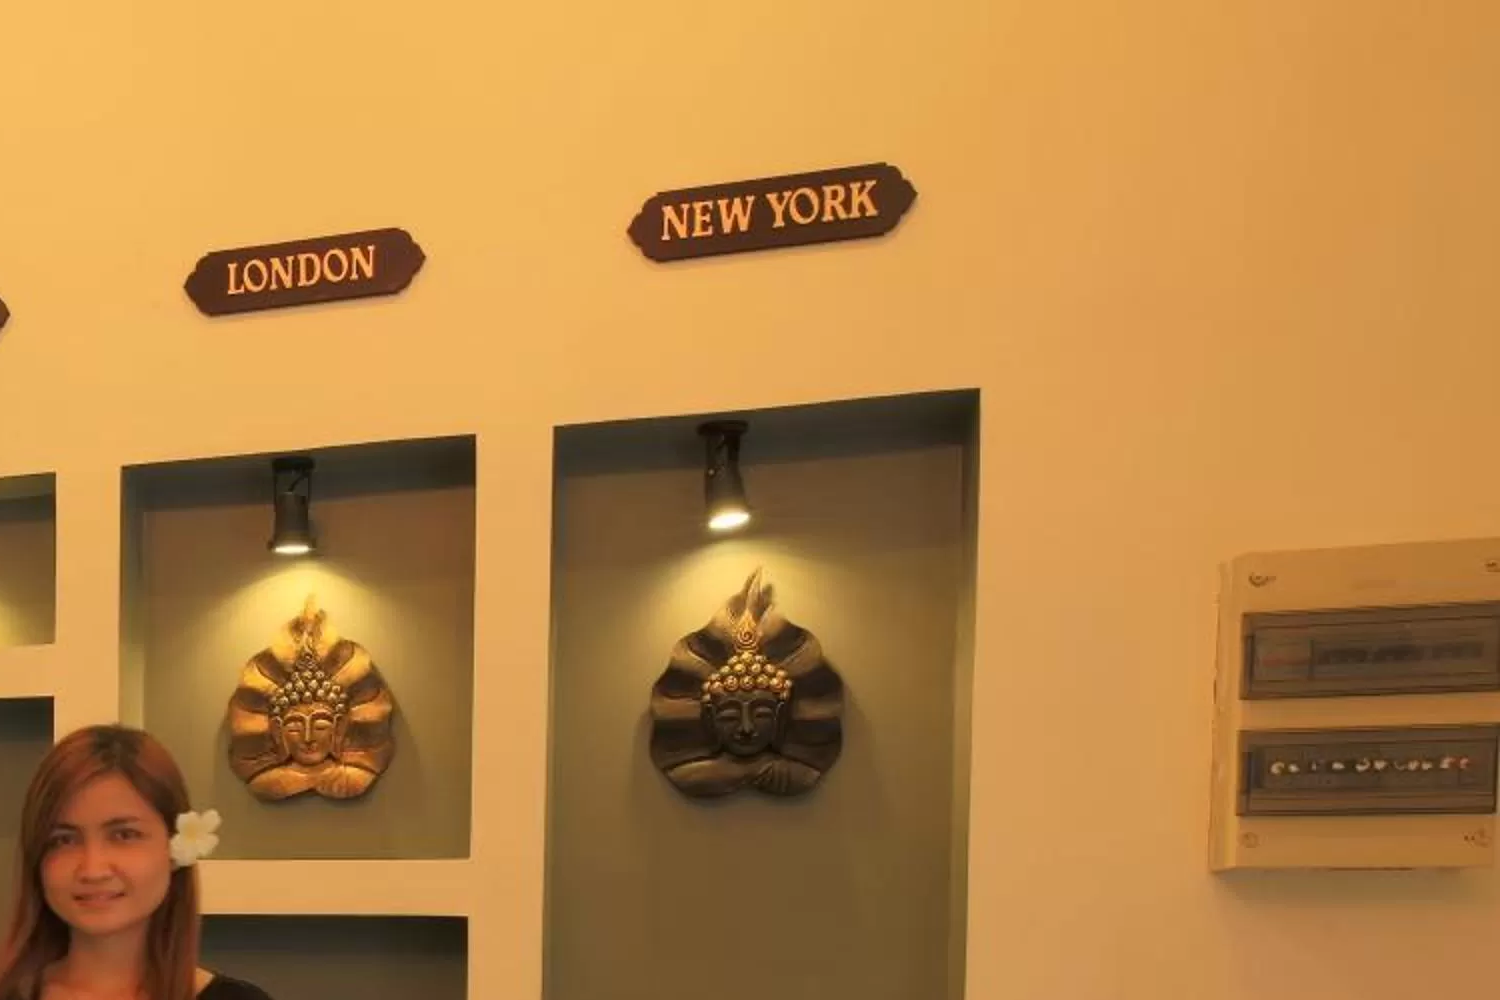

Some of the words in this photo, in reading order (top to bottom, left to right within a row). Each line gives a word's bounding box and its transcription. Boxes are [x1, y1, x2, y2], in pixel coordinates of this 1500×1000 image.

[661, 195, 755, 241] NEW
[765, 180, 879, 229] YORK
[226, 244, 377, 296] LONDON
